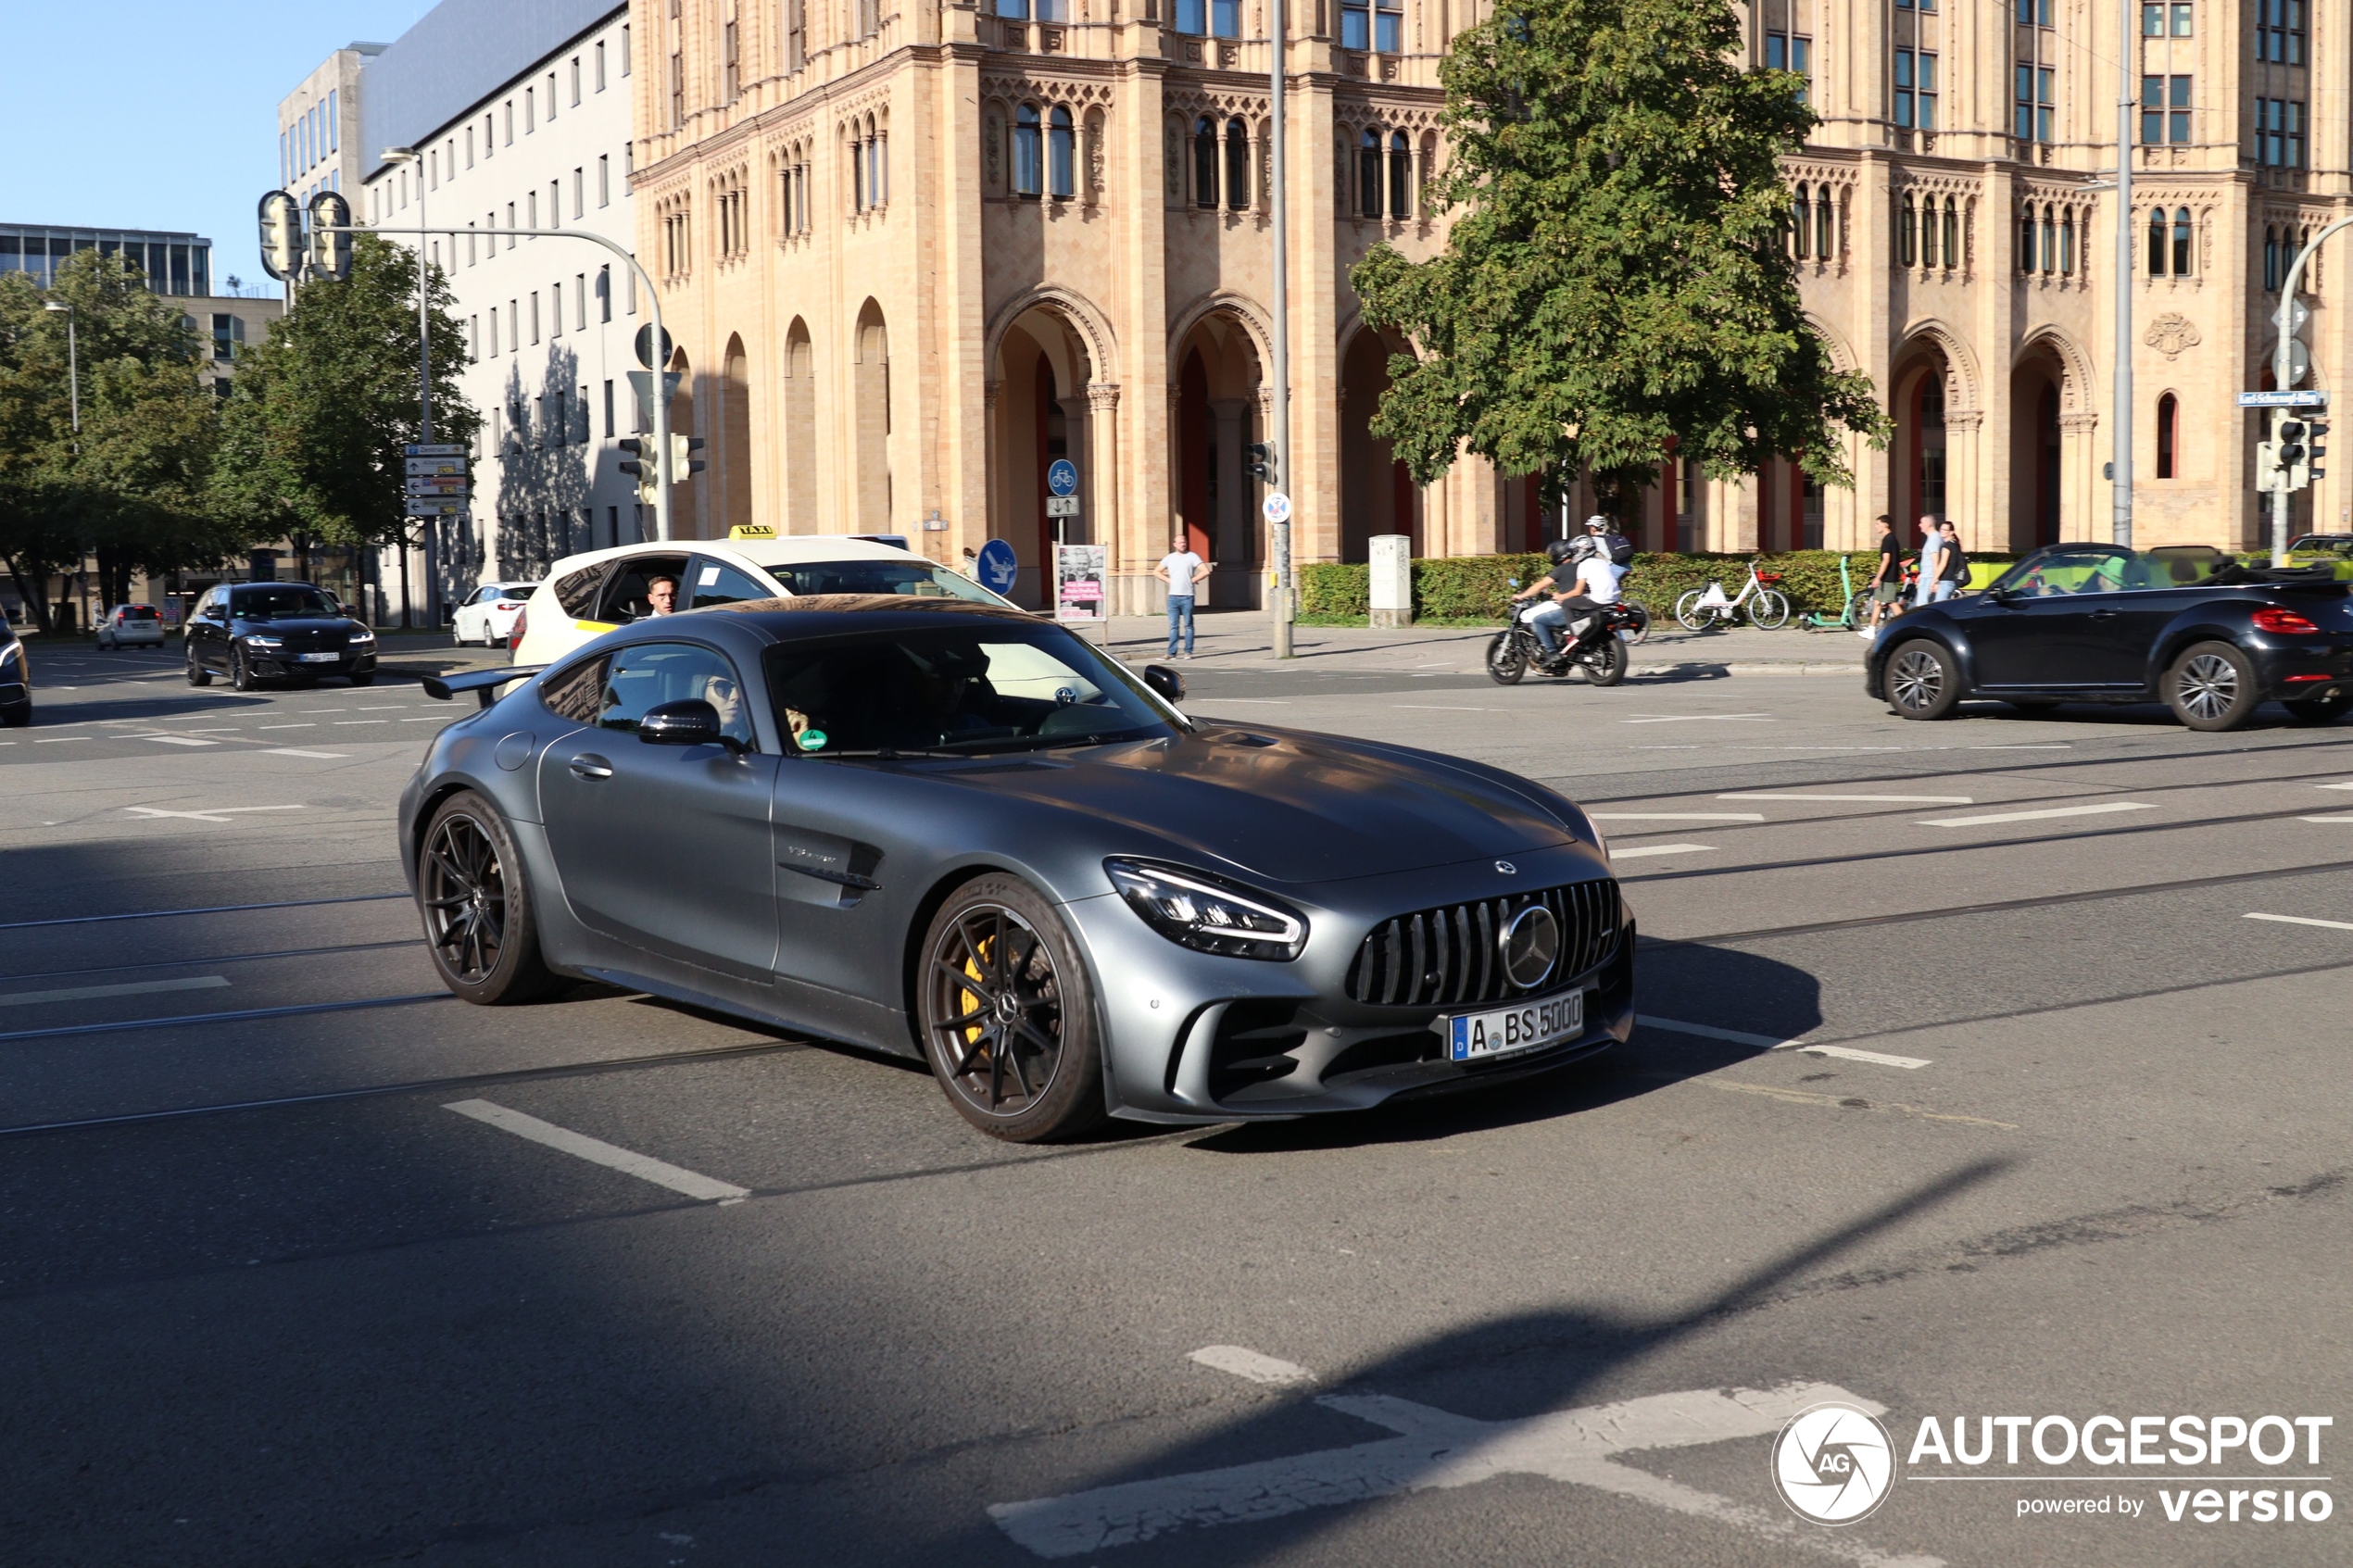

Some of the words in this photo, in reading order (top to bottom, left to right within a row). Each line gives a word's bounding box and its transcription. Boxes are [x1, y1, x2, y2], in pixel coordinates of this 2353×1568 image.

[739, 526, 773, 534] TAXI
[809, 731, 817, 739] 4
[1471, 1019, 1487, 1052] A
[1505, 1009, 1534, 1046] BS
[1539, 995, 1580, 1036] 5000
[1456, 1042, 1465, 1052] D
